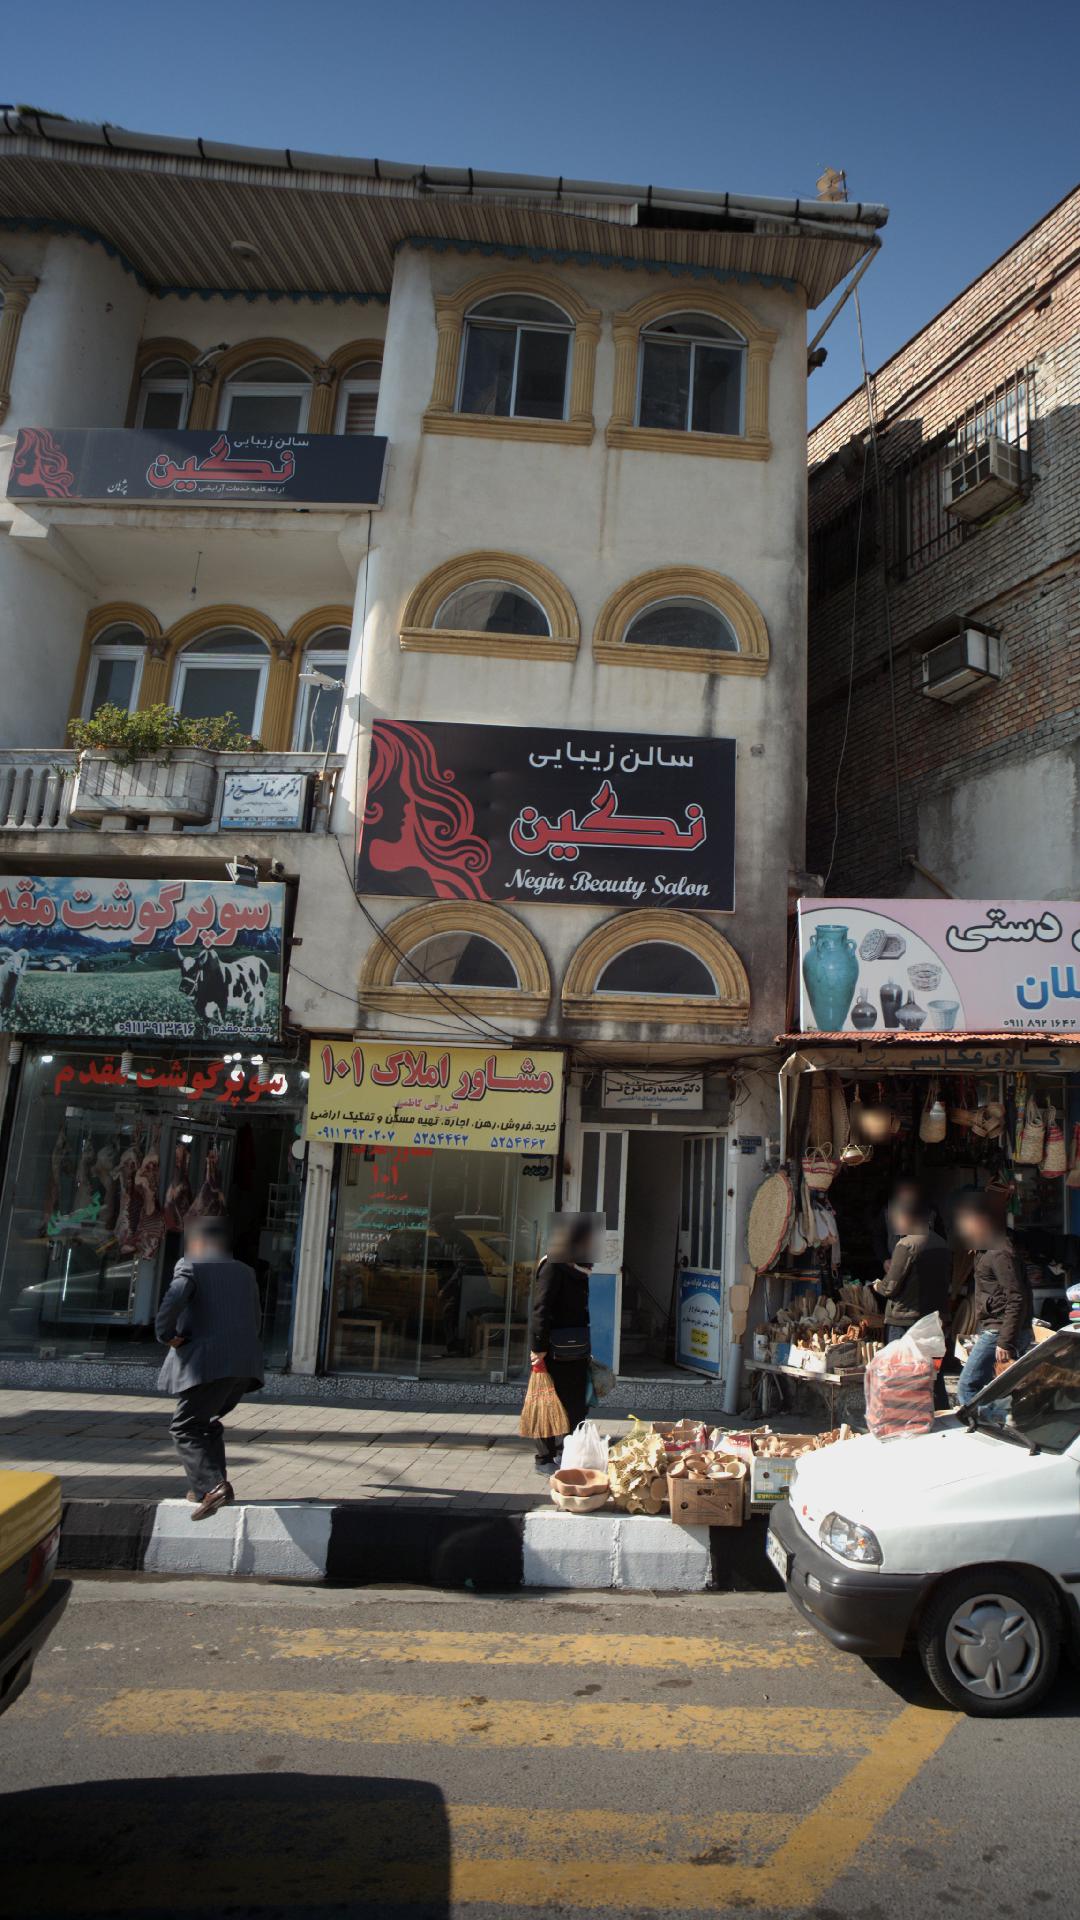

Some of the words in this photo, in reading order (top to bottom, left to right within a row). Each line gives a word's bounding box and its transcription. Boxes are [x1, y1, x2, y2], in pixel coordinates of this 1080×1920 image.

[234, 434, 273, 449] زیبایی
[274, 437, 309, 448] سالن
[147, 434, 295, 493] نگین
[528, 741, 615, 773] زیبایی
[620, 746, 694, 773] سالن
[509, 779, 707, 861] نگین
[505, 868, 566, 895] Negin
[569, 871, 648, 899] Beauty
[651, 875, 710, 897] Salon
[0, 879, 56, 926] مقد
[61, 880, 186, 945] گوشت
[174, 895, 271, 948] سوپر
[946, 908, 1063, 952] دستی
[1016, 965, 1080, 1010] لان
[211, 1024, 239, 1035] مقدم
[239, 1025, 271, 1036] شعیب
[1004, 1019, 1024, 1027] ۰۹۱۱
[1027, 1019, 1047, 1027] ۸۹۲
[54, 1057, 127, 1095] مقدم
[136, 1060, 225, 1099] گوشت
[320, 1044, 365, 1087] ۱۰۱
[370, 1049, 451, 1088] املاک
[452, 1055, 554, 1101] مشاور
[216, 1070, 285, 1107] سوپر
[681, 1083, 701, 1095] دکتر
[310, 1109, 340, 1120] اراضی
[343, 1111, 374, 1123] تفکیک
[376, 1114, 383, 1124] و
[385, 1113, 415, 1124] مسکن
[317, 1126, 339, 1138] ۰۹۱۱
[344, 1127, 365, 1140] ۳۹۲
[368, 1130, 395, 1142] ۰۲۰۷
[372, 1164, 398, 1185] ۱۰۱
